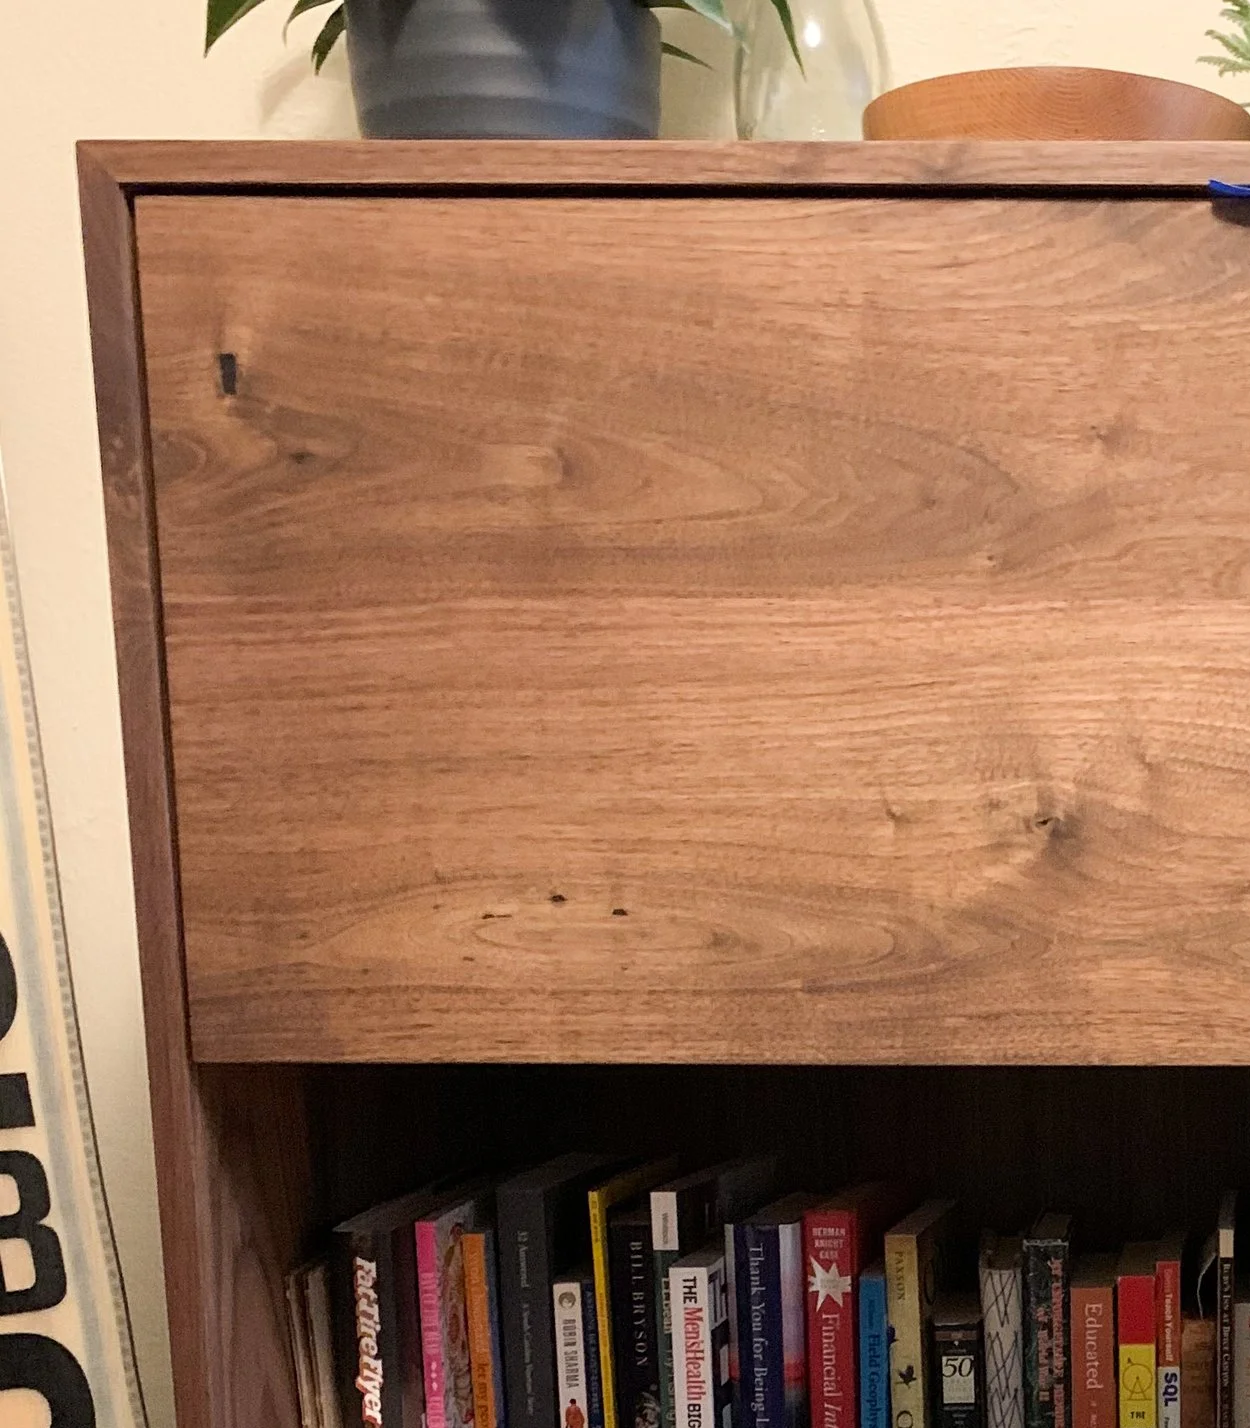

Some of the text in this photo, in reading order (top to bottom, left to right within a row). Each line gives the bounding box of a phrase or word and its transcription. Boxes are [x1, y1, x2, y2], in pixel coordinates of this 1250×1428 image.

[353, 1256, 378, 1300] Fat
[682, 1276, 698, 1305] THE
[748, 1243, 767, 1295] Thank
[629, 1240, 650, 1366] BILL BRYSON
[752, 1302, 767, 1332] You
[355, 1298, 382, 1357] Tire
[1084, 1302, 1105, 1391] Educated
[1164, 1292, 1177, 1362] Teach Yourself
[562, 1318, 581, 1389] ROBIN SHARMA
[754, 1337, 769, 1362] for
[821, 1312, 844, 1398] Financial
[941, 1357, 974, 1379] 50
[477, 1381, 491, 1401] my
[751, 1366, 770, 1413] Being
[1164, 1372, 1179, 1407] SQL
[687, 1402, 702, 1428] BIG
[1129, 1411, 1146, 1421] THE
